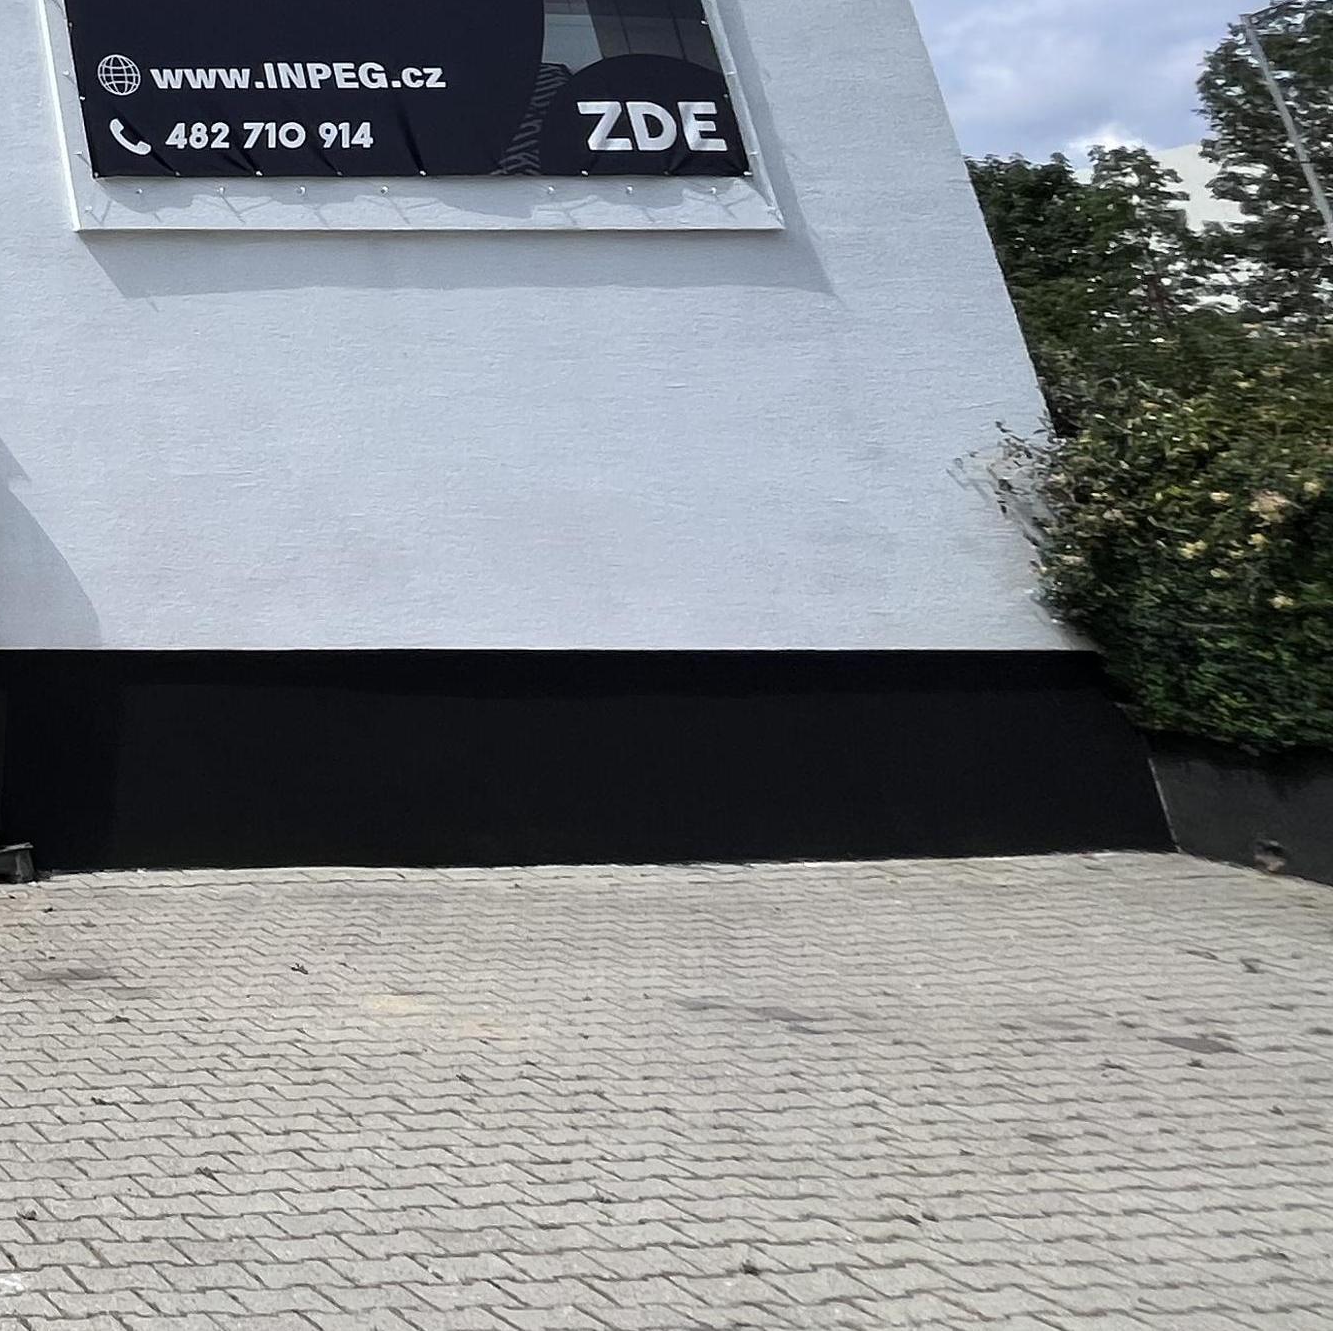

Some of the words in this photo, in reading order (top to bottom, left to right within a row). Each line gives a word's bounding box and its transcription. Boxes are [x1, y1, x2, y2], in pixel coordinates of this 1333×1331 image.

[148, 61, 448, 90] www.INPEG.cz
[164, 121, 231, 150] 482
[242, 121, 307, 150] 710
[317, 121, 375, 150] 914
[576, 100, 729, 152] ZDE
